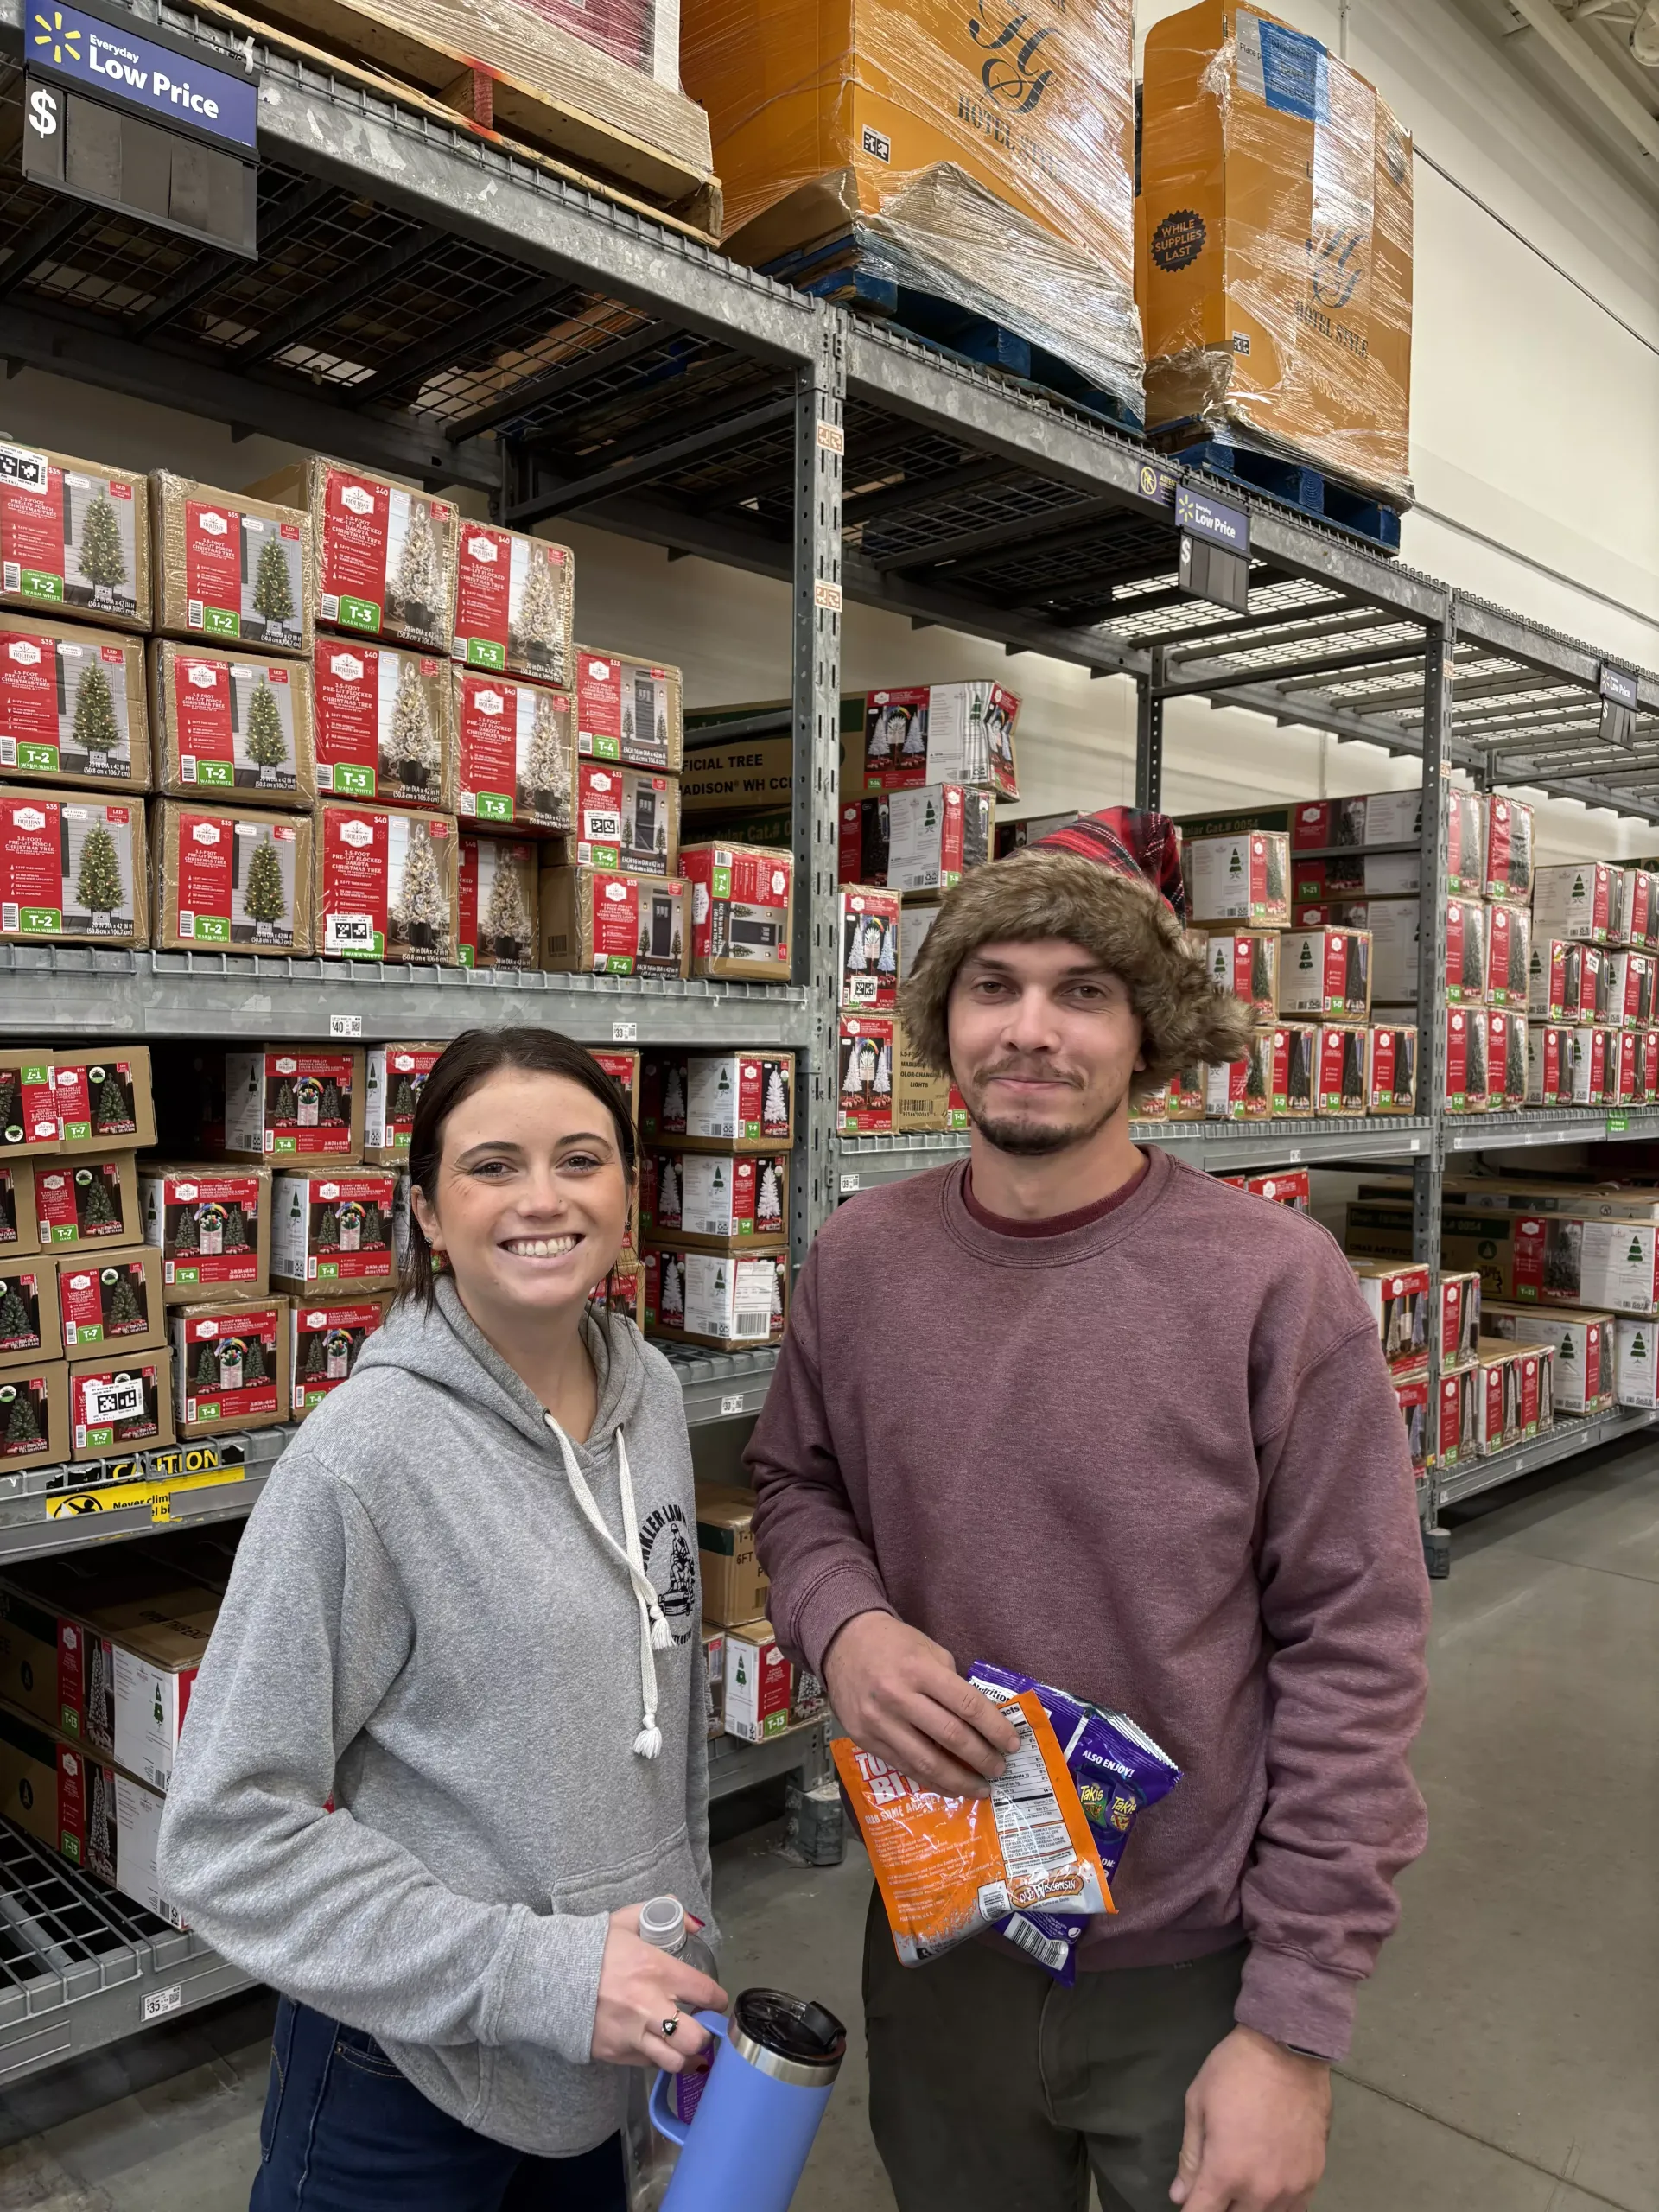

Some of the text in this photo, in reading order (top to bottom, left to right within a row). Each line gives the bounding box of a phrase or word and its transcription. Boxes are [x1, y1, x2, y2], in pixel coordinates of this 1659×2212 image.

[89, 34, 140, 63] Everyday
[89, 45, 219, 119] Low Price
[29, 88, 57, 138] $
[957, 92, 1015, 150] HOTEL
[1161, 219, 1195, 238] WHILE
[1154, 229, 1203, 252] SUPPLIES
[1166, 246, 1192, 262] LAST
[1296, 300, 1369, 359] HOTEL STYLE
[376, 486, 389, 497] $40
[7, 503, 41, 514] CHRISTMAS
[41, 509, 57, 518] TREE
[11, 499, 54, 512] PRE-LIT PORCH
[355, 521, 382, 536] FLOCKED
[1195, 510, 1236, 538] Low Price
[346, 525, 369, 537] DAKOTA
[498, 536, 510, 544] $40
[192, 544, 220, 555] CHRISTMAS
[215, 544, 232, 553] PORCH
[1181, 538, 1191, 566] $
[472, 573, 493, 582] DAKOTA
[481, 569, 505, 581] FLOCKED
[31, 578, 54, 594] T-2
[348, 605, 372, 622] T-3
[213, 614, 232, 629] T-2
[364, 651, 378, 659] $40
[476, 647, 497, 662] T-3
[323, 685, 373, 699] PRE-LIT FLOCKED
[335, 693, 360, 702] DAKOTA
[322, 696, 357, 707] CHRISTMAS
[598, 741, 614, 753] T-4
[27, 750, 50, 764] T-2
[683, 754, 763, 772] FICIAL TREE
[206, 767, 226, 779] T-2
[343, 772, 366, 787] T-3
[743, 779, 765, 791] WH
[486, 800, 505, 815] T-3
[374, 816, 387, 824] $40
[1234, 818, 1259, 830] 0054
[597, 851, 613, 862] T-4
[29, 916, 53, 927] T-2
[202, 923, 223, 935] T-2
[613, 961, 628, 971] T-4
[332, 1021, 344, 1033] $40
[70, 1128, 86, 1136] T-7
[57, 1229, 73, 1237] T-7
[82, 1329, 98, 1338] T-7
[92, 1433, 108, 1442] T-7
[113, 1492, 171, 1510] Never clim
[737, 1551, 753, 1565] 6FT
[1083, 1750, 1135, 1778] ALSO ENJOY!
[1080, 1783, 1103, 1802] Takis
[1102, 1858, 1116, 1868] ON:
[147, 2000, 160, 2014] $35
